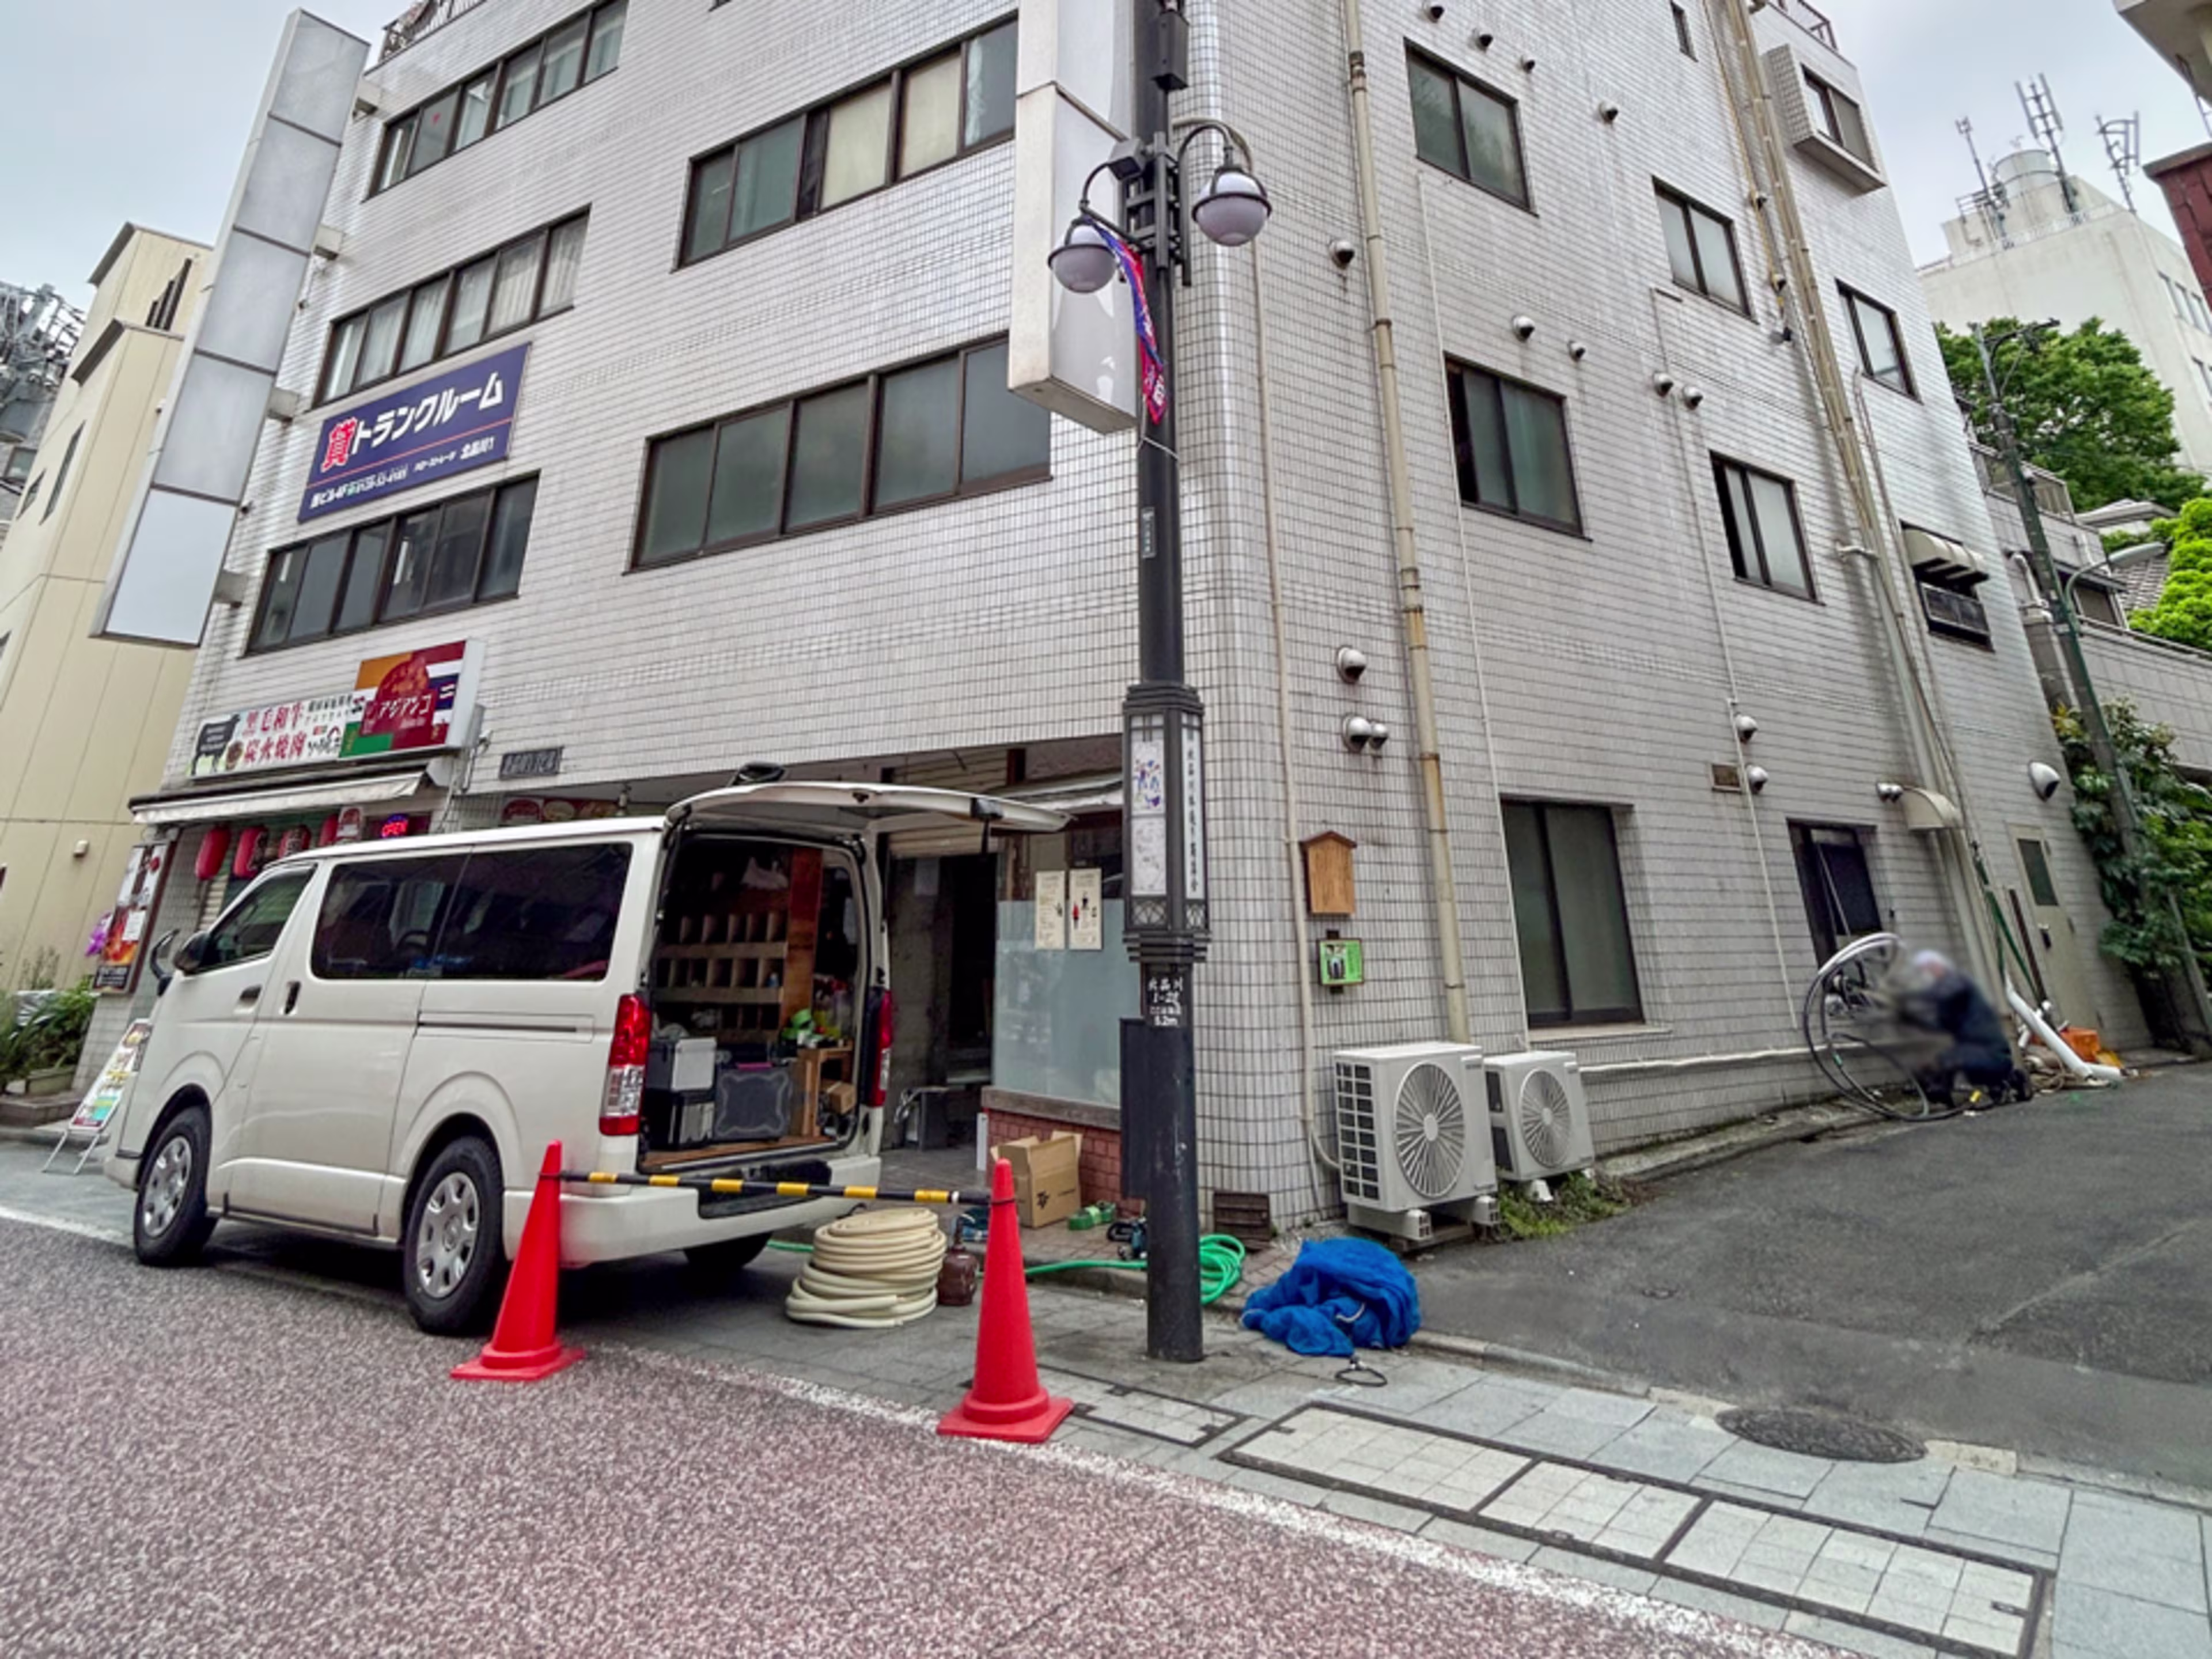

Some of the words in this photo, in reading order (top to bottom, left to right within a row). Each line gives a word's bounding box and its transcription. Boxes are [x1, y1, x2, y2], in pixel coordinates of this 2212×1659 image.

[321, 372, 503, 472] 貸トランクルーム
